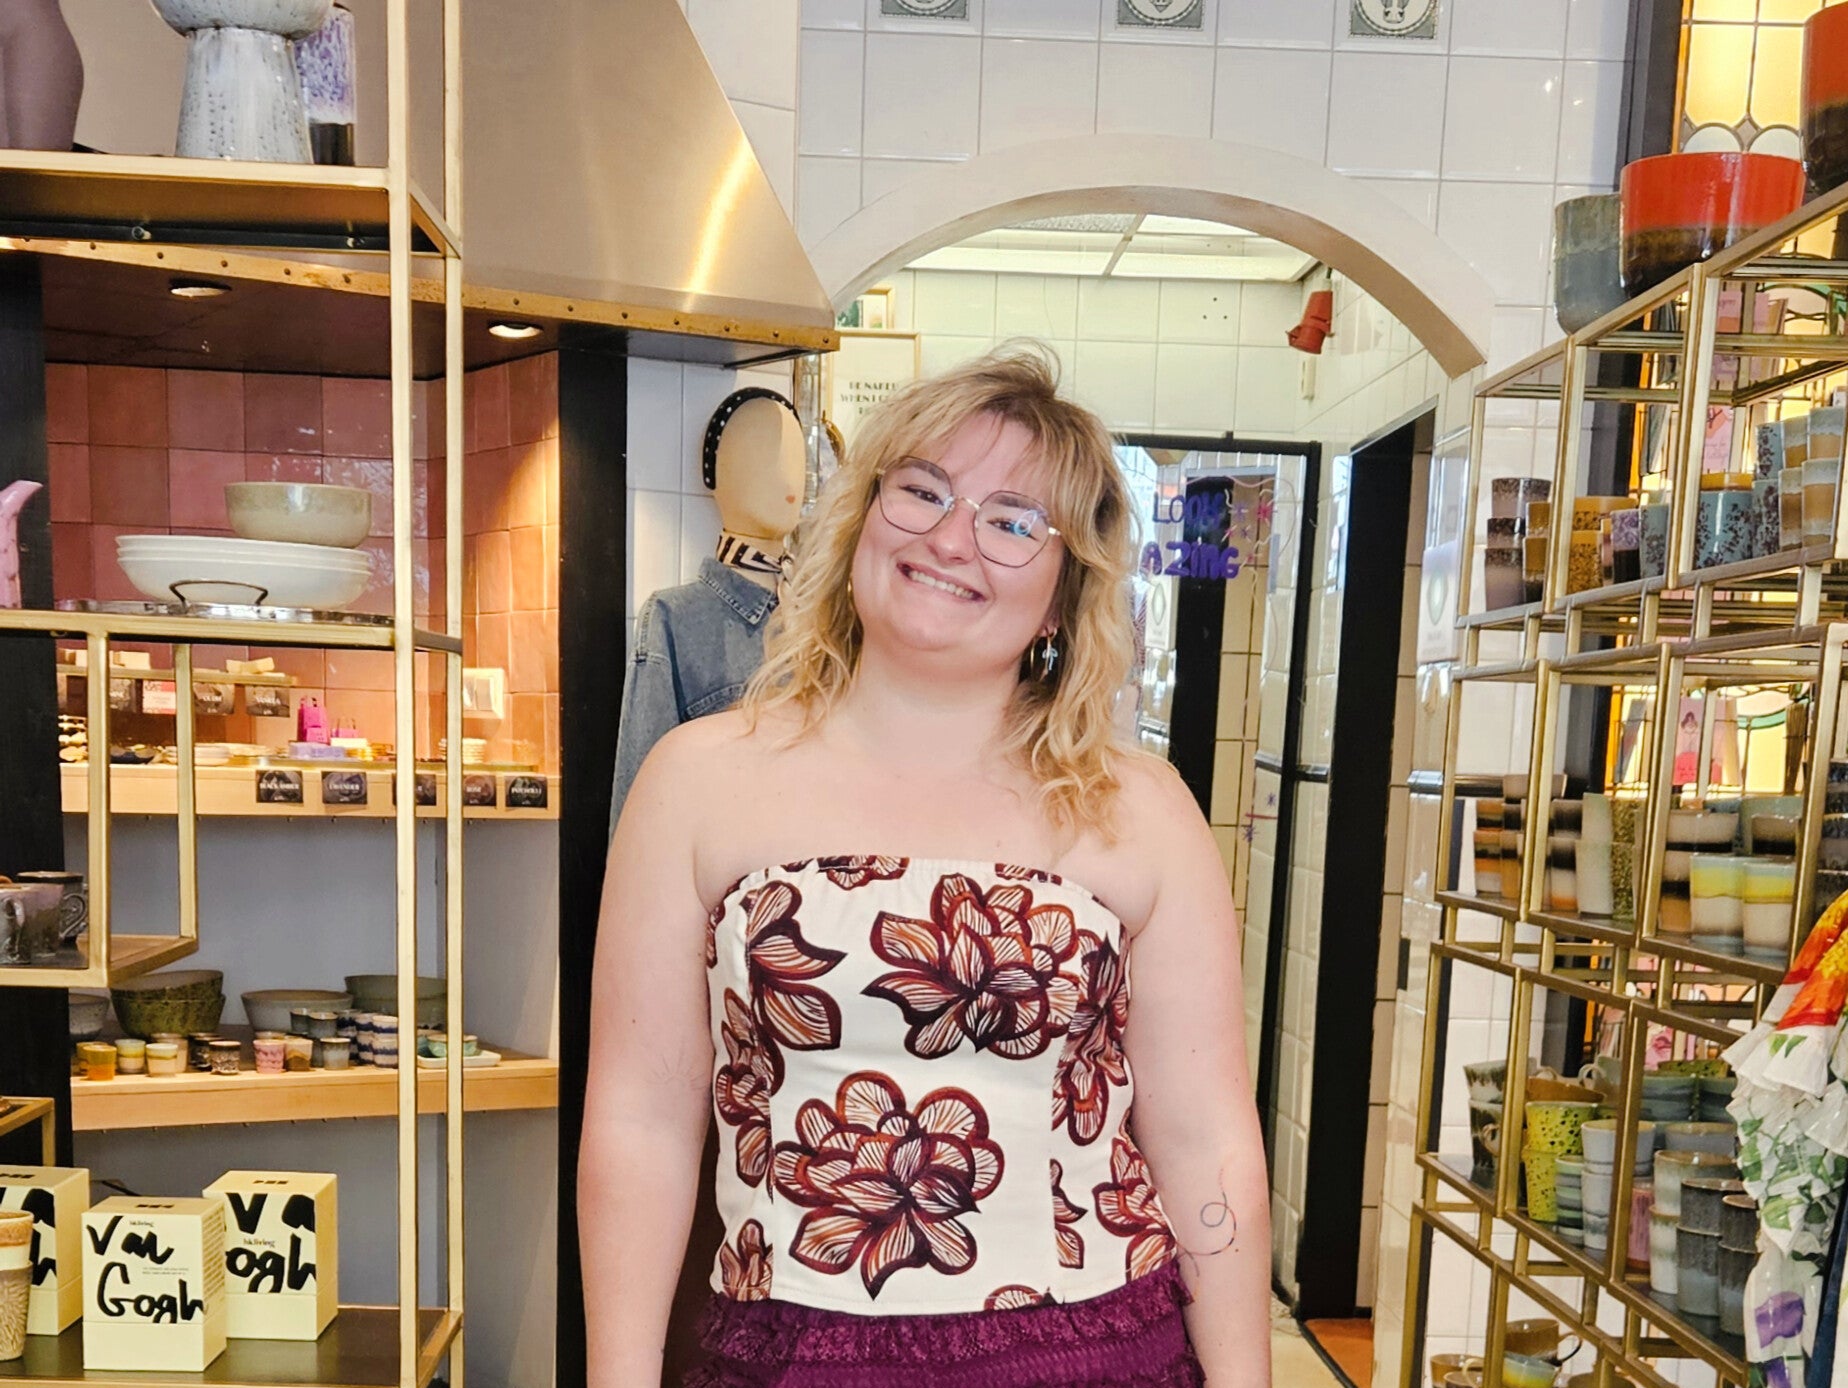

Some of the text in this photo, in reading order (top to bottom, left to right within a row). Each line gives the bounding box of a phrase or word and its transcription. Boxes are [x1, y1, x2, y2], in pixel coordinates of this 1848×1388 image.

[1153, 491, 1224, 528] LOOK
[86, 1215, 175, 1265] Van
[97, 1261, 206, 1323] Gogh
